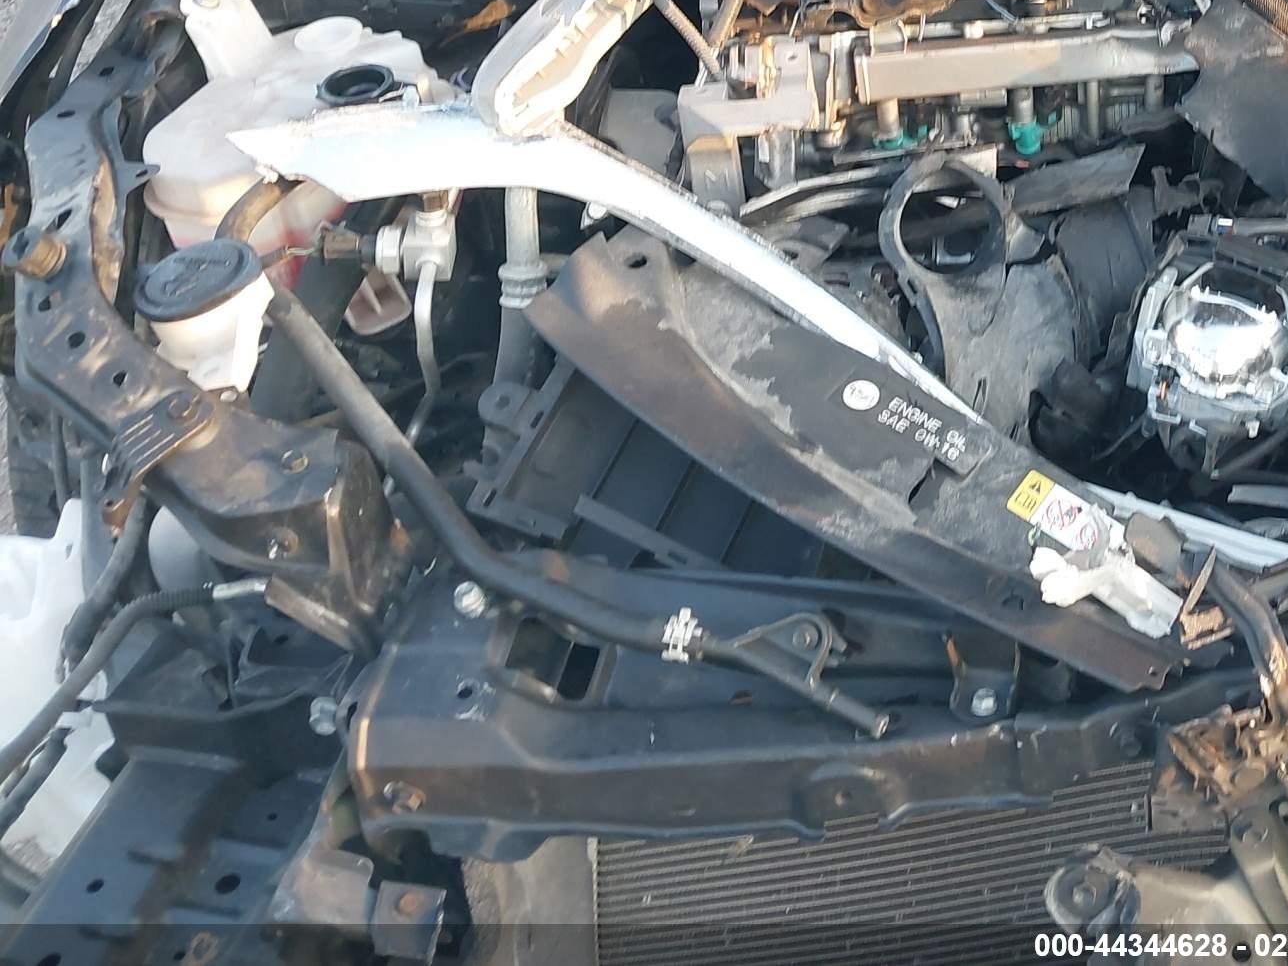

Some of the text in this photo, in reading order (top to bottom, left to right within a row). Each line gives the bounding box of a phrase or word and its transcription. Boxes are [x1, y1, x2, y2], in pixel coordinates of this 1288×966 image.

[878, 409, 910, 434] SAE
[888, 397, 966, 452] ENGINE OIL
